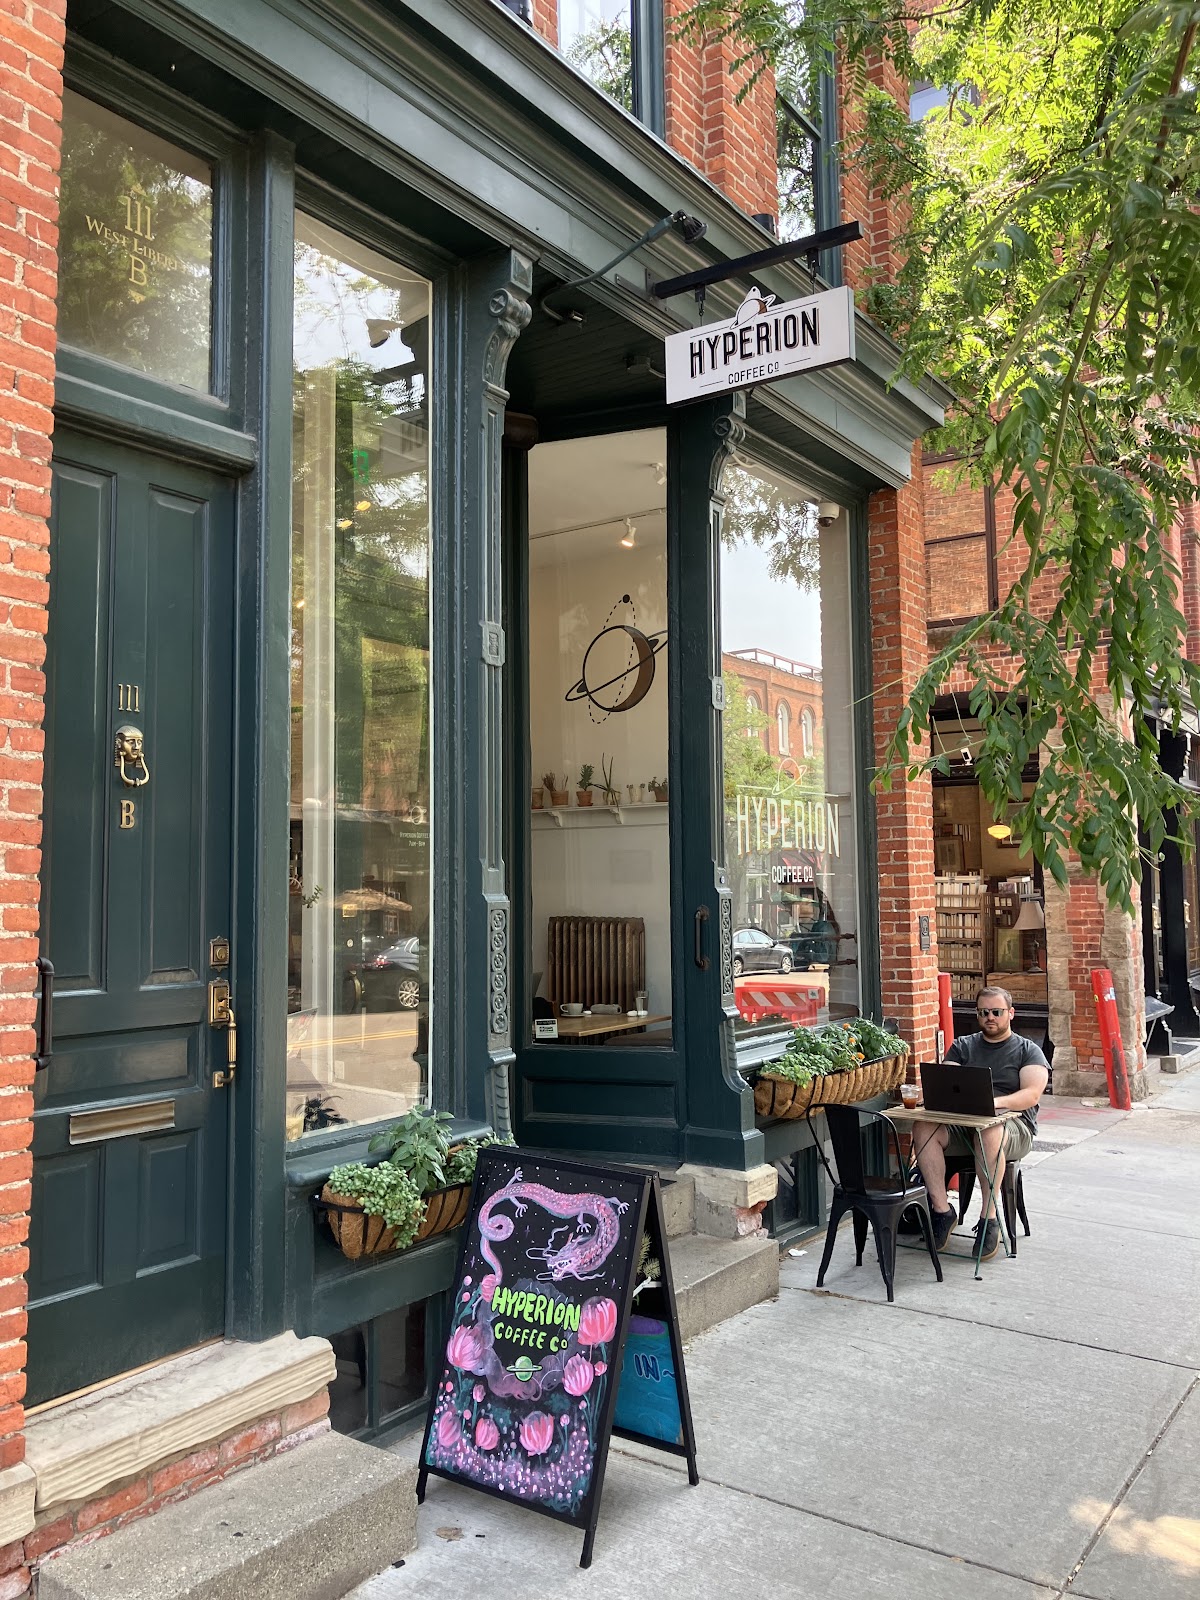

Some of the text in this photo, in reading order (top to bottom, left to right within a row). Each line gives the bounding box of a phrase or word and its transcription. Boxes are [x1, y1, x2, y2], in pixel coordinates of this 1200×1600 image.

[124, 196, 153, 241] 111
[128, 254, 148, 286] B
[689, 307, 820, 379] HYPERION
[728, 363, 765, 385] COFFEE
[117, 683, 140, 713] 111
[119, 799, 136, 829] B
[736, 794, 840, 858] HYPERION
[771, 865, 802, 884] COFFEE
[491, 1286, 581, 1332] HYPERION
[494, 1322, 547, 1350] COFFEE
